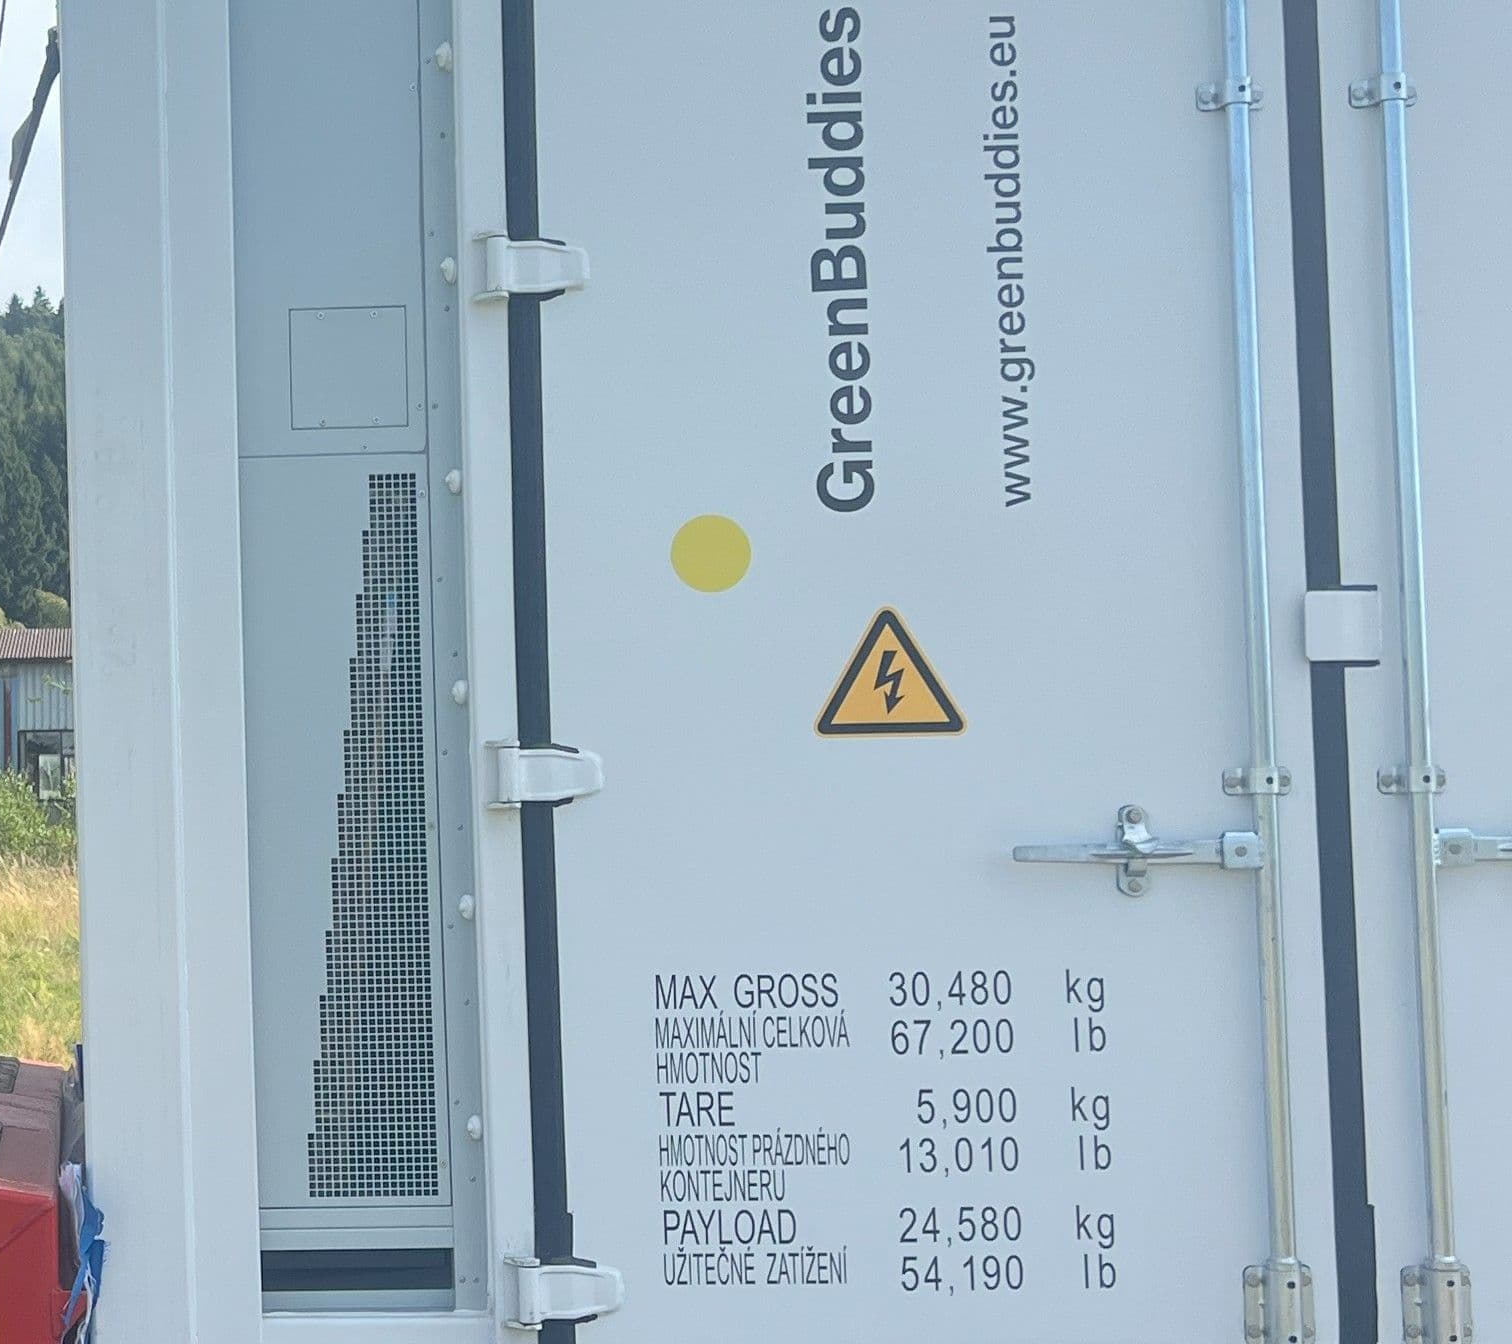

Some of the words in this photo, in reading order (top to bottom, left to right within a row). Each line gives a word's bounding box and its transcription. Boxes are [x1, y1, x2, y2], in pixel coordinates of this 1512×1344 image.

[806, 6, 875, 512] GreenBuddies
[983, 15, 1035, 508] www.greenbuddies.eu
[655, 974, 717, 1010] MAX
[734, 973, 839, 1010] GROSS
[888, 970, 1012, 1011] 30,480
[1065, 968, 1105, 1012] kg
[655, 1010, 757, 1049] MAXIMÁLNÍ
[762, 1009, 850, 1049] CELKOVÁ
[890, 1019, 1015, 1060] 67,200
[1073, 1017, 1106, 1053] lb
[656, 1052, 761, 1084] HMOTNOST
[659, 1090, 735, 1127] TARE
[916, 1088, 1017, 1129] 5,900
[1070, 1086, 1111, 1131] kg
[658, 1133, 748, 1166] HMOTNOST
[752, 1126, 851, 1166] PRÁZDNÉHO
[899, 1136, 1019, 1177] 13,010
[1078, 1134, 1112, 1170] lb
[660, 1169, 786, 1202] KONTEJNERU
[663, 1208, 797, 1245] PAYLOAD
[899, 1206, 1022, 1247] 24,580
[1076, 1204, 1116, 1249] kg
[663, 1245, 755, 1286] UŽITEČNÉ
[766, 1245, 848, 1285] ZATÍŽENÍ
[900, 1255, 1024, 1296] 54,190
[1083, 1253, 1117, 1289] lb
